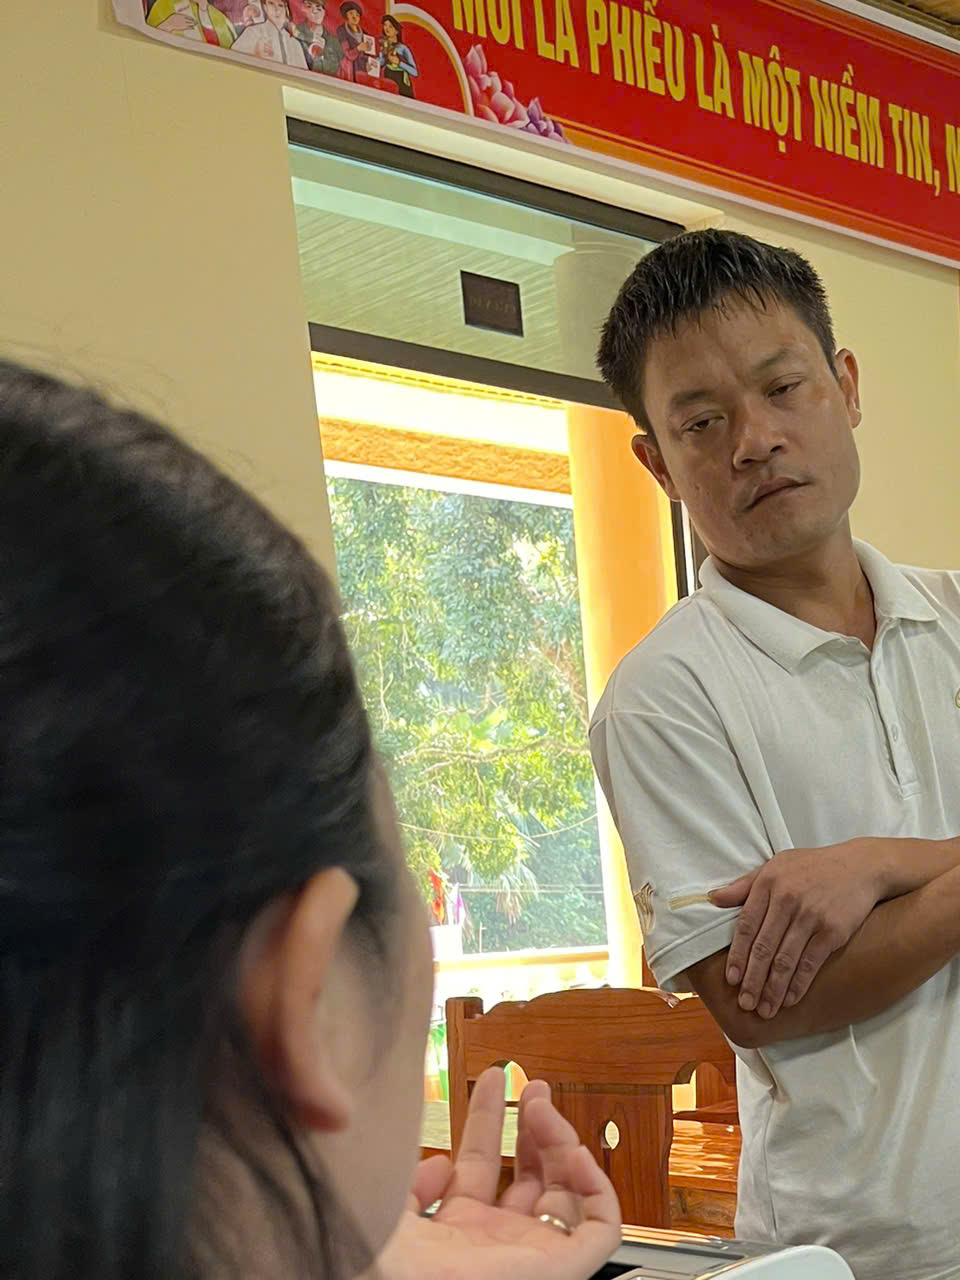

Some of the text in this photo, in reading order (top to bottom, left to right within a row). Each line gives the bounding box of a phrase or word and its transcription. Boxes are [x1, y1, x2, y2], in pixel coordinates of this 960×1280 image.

[586, 0, 686, 102] PHIẾU
[691, 23, 736, 119] LÀ
[737, 44, 802, 154] MỘT
[809, 63, 885, 169] NIỀM
[887, 102, 941, 197] TIN,
